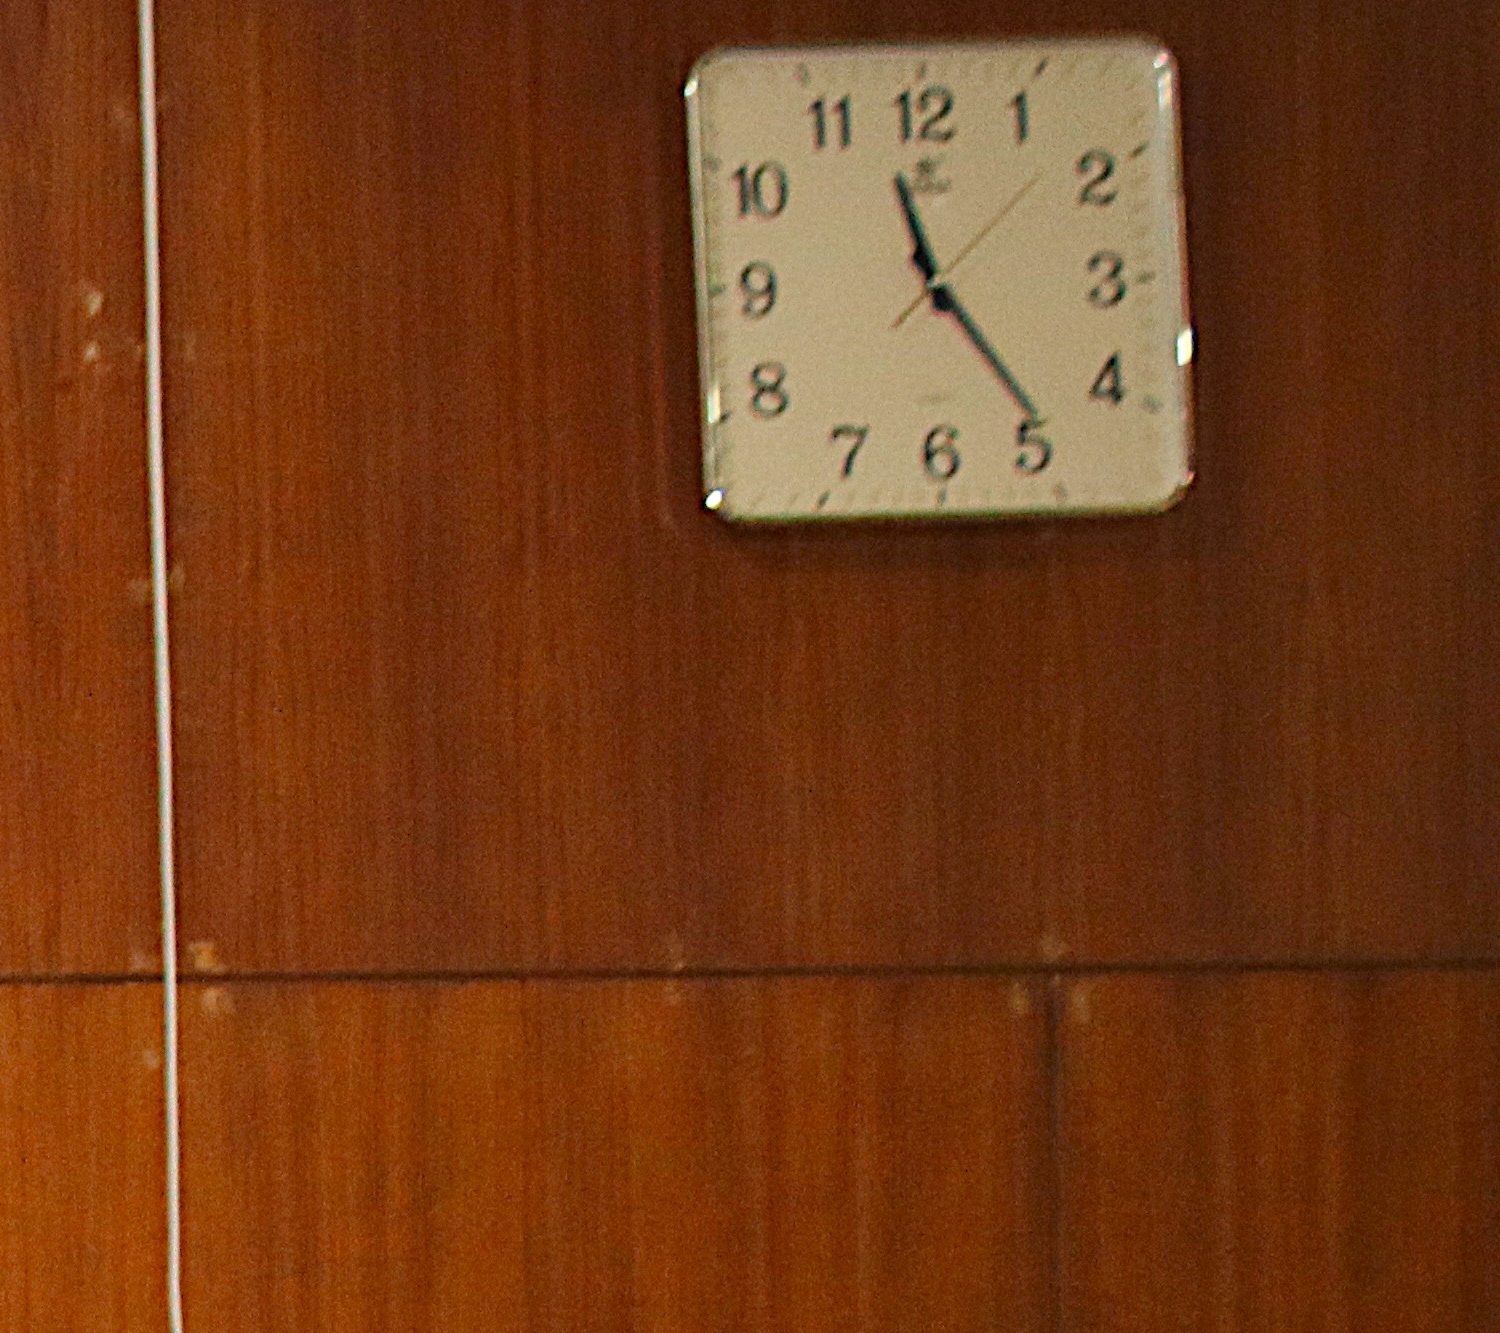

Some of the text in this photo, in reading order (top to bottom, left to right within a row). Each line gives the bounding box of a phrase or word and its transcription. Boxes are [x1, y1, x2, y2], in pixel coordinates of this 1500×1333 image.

[808, 96, 852, 149] 11
[894, 86, 956, 143] 12
[1009, 91, 1029, 142] 1
[732, 161, 789, 218] 10
[1076, 150, 1116, 205] 2
[739, 261, 777, 317] 9
[1087, 251, 1126, 306] 3
[750, 362, 789, 418] 8
[1089, 353, 1125, 406] 4
[832, 425, 871, 478] 7
[924, 425, 961, 480] 6
[1015, 420, 1053, 473] 5
